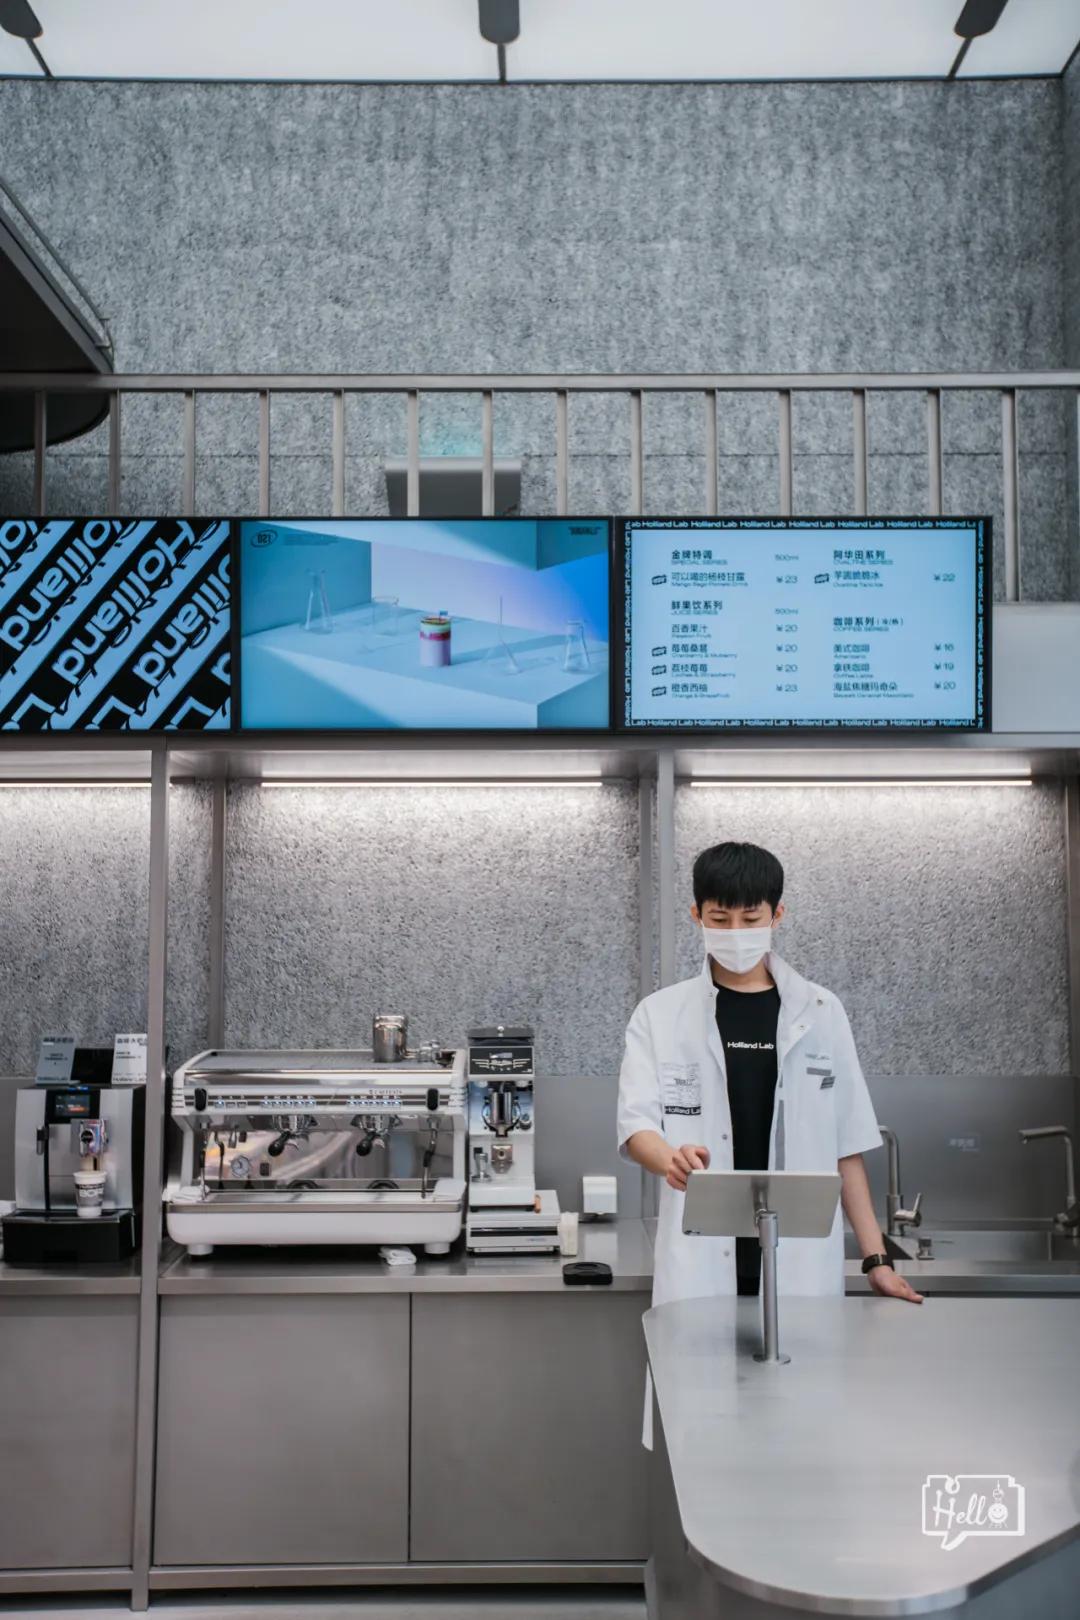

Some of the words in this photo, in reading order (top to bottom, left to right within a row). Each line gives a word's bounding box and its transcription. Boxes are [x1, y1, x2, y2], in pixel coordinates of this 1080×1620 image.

[672, 550, 712, 560] 金牌特调
[833, 550, 885, 560] 阿华田系列
[672, 600, 722, 610] 鲜果饮系列
[672, 624, 708, 633] 百香果汁
[834, 644, 870, 653] 美式咖啡
[834, 663, 870, 672] 拿铁咖啡
[759, 1042, 774, 1050] Lab
